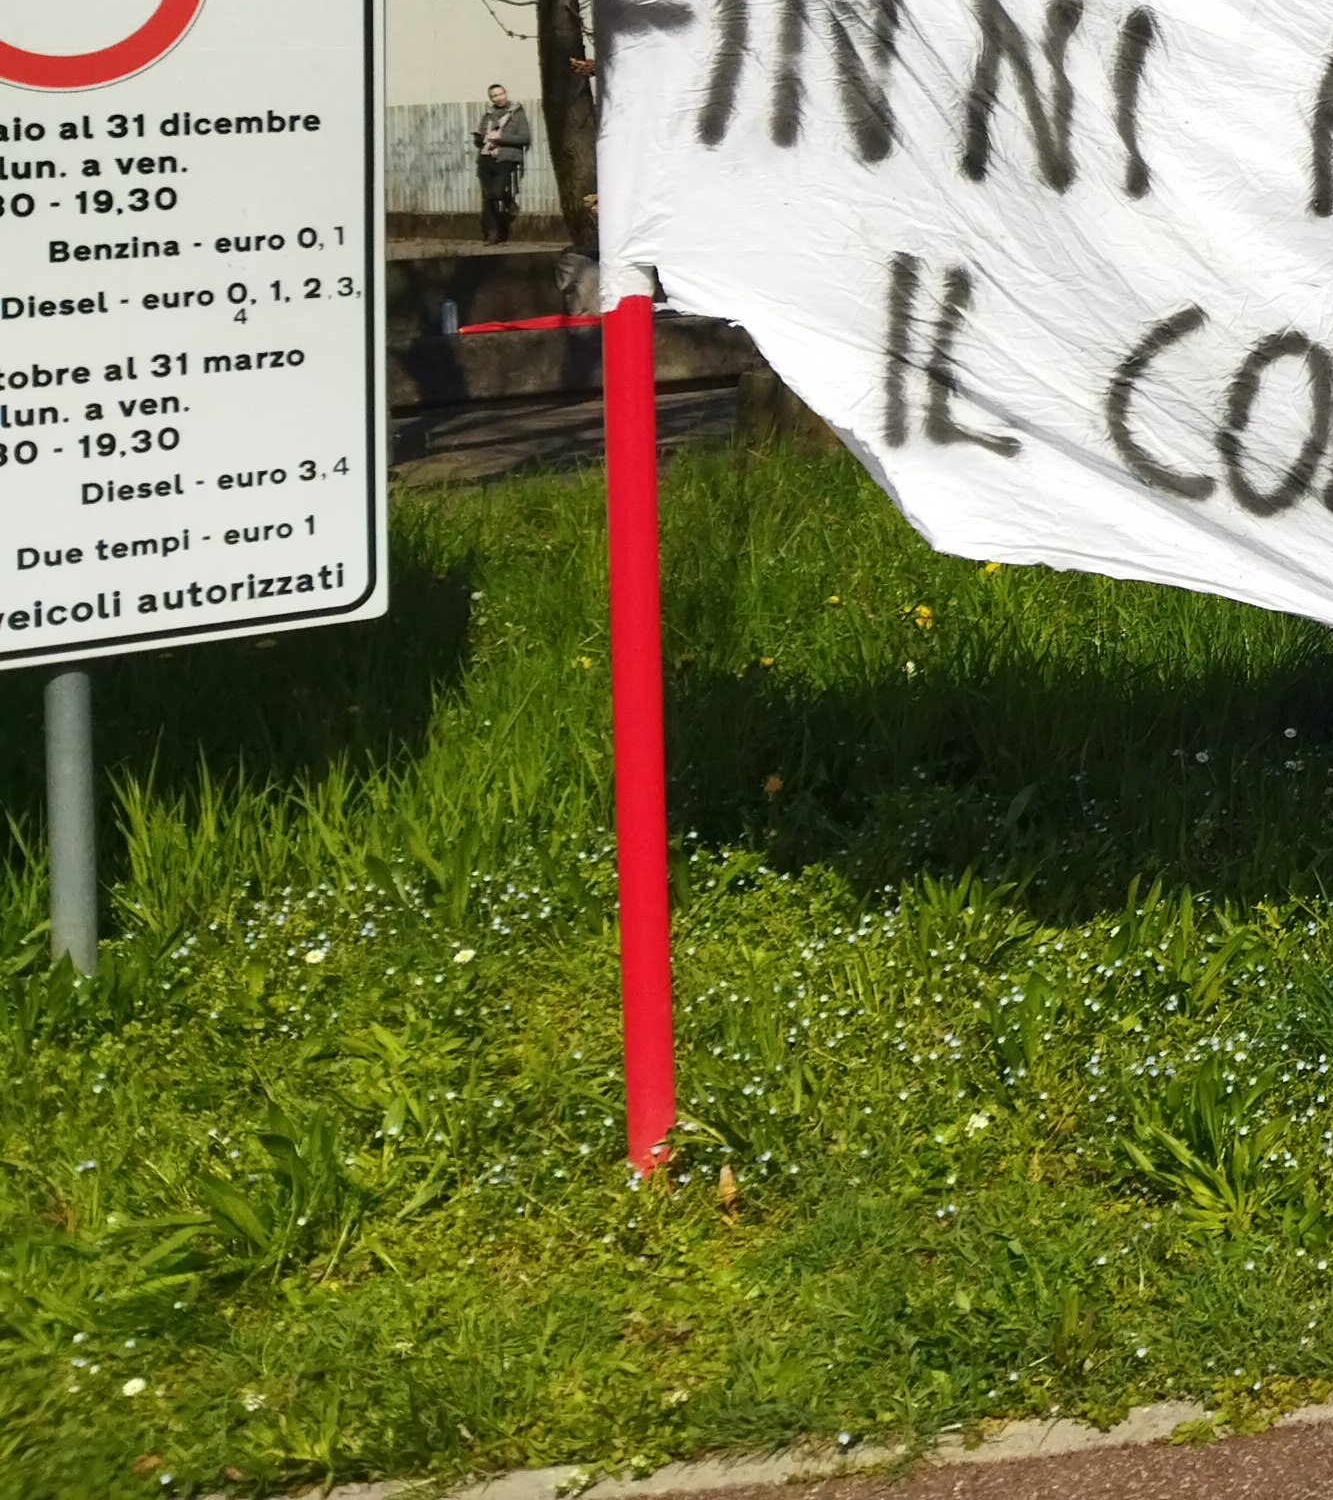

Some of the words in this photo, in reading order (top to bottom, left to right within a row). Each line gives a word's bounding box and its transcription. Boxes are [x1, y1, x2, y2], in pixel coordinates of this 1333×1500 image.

[59, 115, 94, 140] al
[106, 113, 146, 139] 31
[159, 110, 321, 137] dicembre
[0, 156, 67, 180] lun.
[81, 158, 101, 178] a
[115, 155, 189, 176] ven.
[49, 237, 181, 263] Benzina
[214, 232, 286, 253] euro
[1, 291, 109, 320] Diesel
[141, 289, 215, 311] euro
[233, 308, 249, 325] 4
[103, 356, 138, 381] al
[150, 352, 189, 378] 31
[203, 349, 305, 374] marzo
[884, 251, 1023, 457] IL
[1, 404, 70, 429] lun.
[84, 403, 104, 422] a
[118, 395, 190, 418] ven.
[81, 474, 184, 505] Diesel
[217, 467, 287, 491] euro
[17, 546, 84, 571] Due
[95, 529, 191, 558] tempi
[224, 521, 293, 546] euro
[304, 514, 316, 536] 1
[0, 590, 121, 631] eicoli
[137, 562, 345, 615] autorizzati
